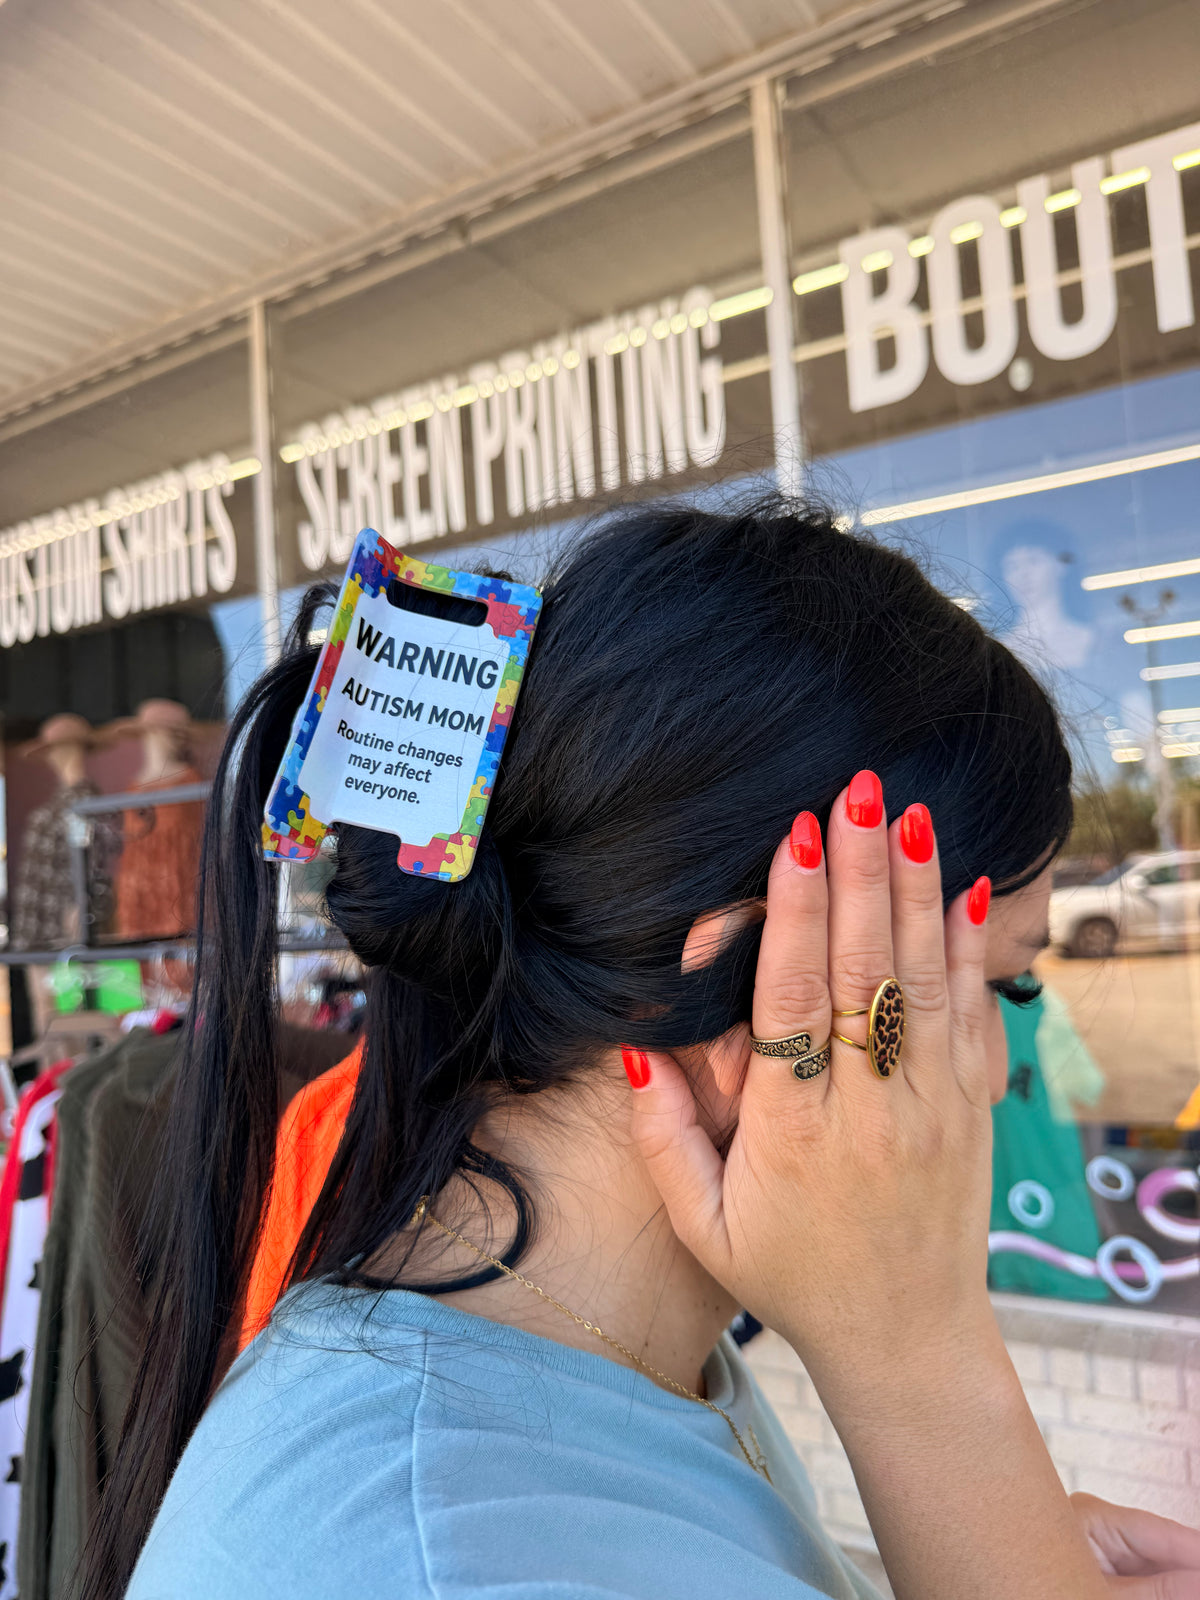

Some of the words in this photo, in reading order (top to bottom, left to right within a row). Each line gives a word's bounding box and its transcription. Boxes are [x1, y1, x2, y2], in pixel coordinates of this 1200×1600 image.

[296, 372, 467, 571] SCREEN
[468, 287, 726, 525] PRINTING
[103, 452, 238, 620] SHIRTS
[356, 617, 499, 689] WARNING
[341, 677, 424, 722] AUTISM
[427, 706, 485, 735] MOM
[337, 719, 394, 753] Routine
[397, 740, 463, 768] changes
[349, 754, 380, 774] may
[384, 761, 432, 783] affect
[344, 776, 420, 804] everyone.
